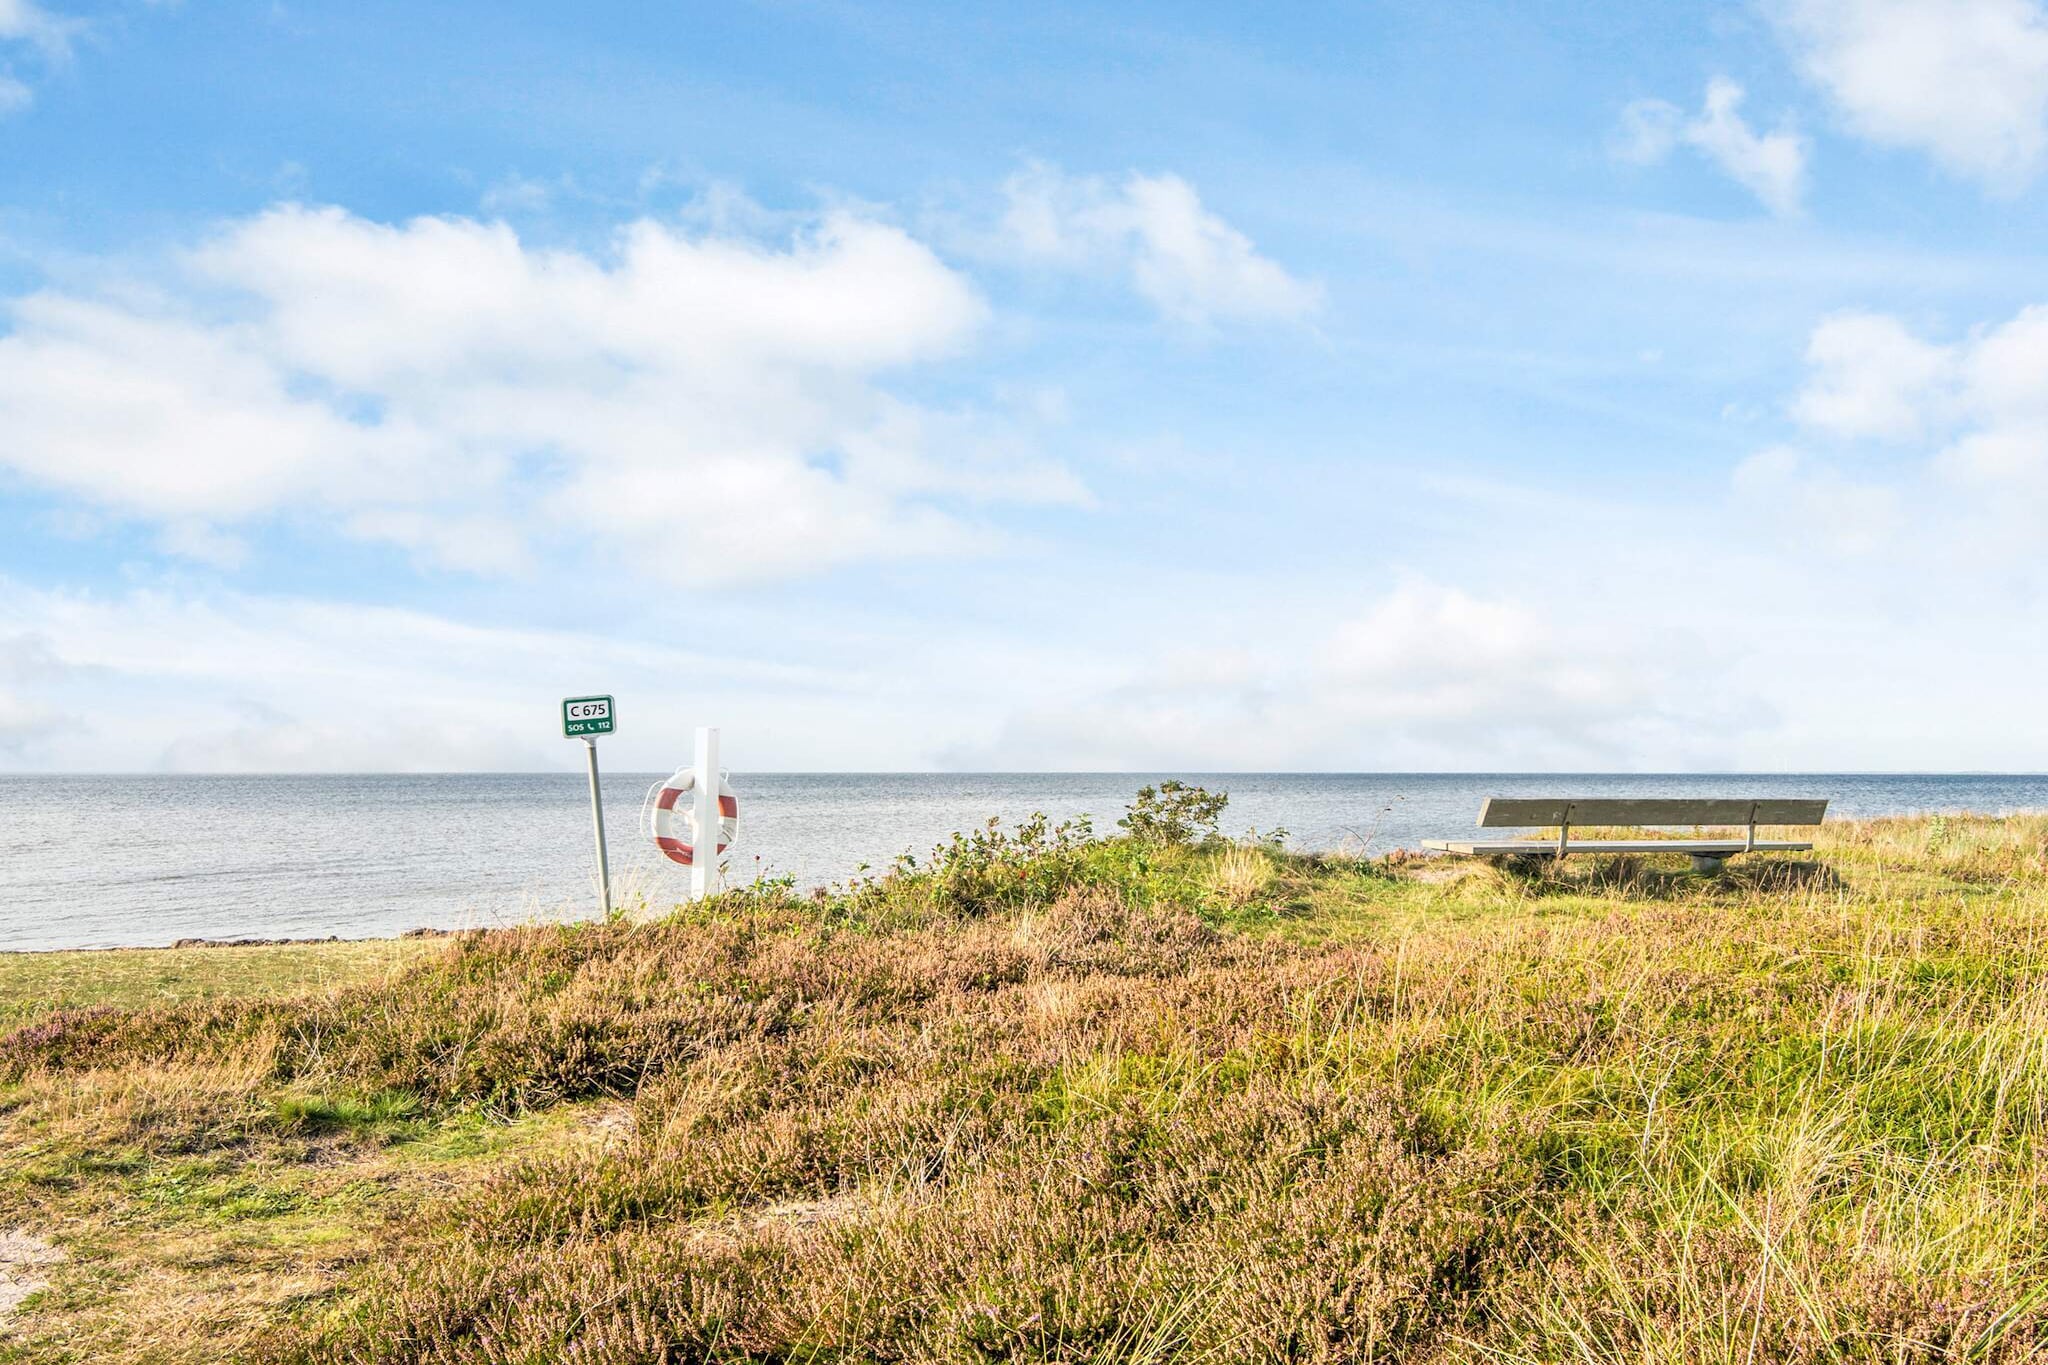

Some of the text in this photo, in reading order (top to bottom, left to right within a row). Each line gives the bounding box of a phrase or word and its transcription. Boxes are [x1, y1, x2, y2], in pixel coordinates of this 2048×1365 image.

[570, 704, 605, 716] C 675
[568, 721, 610, 732] SOS 112
